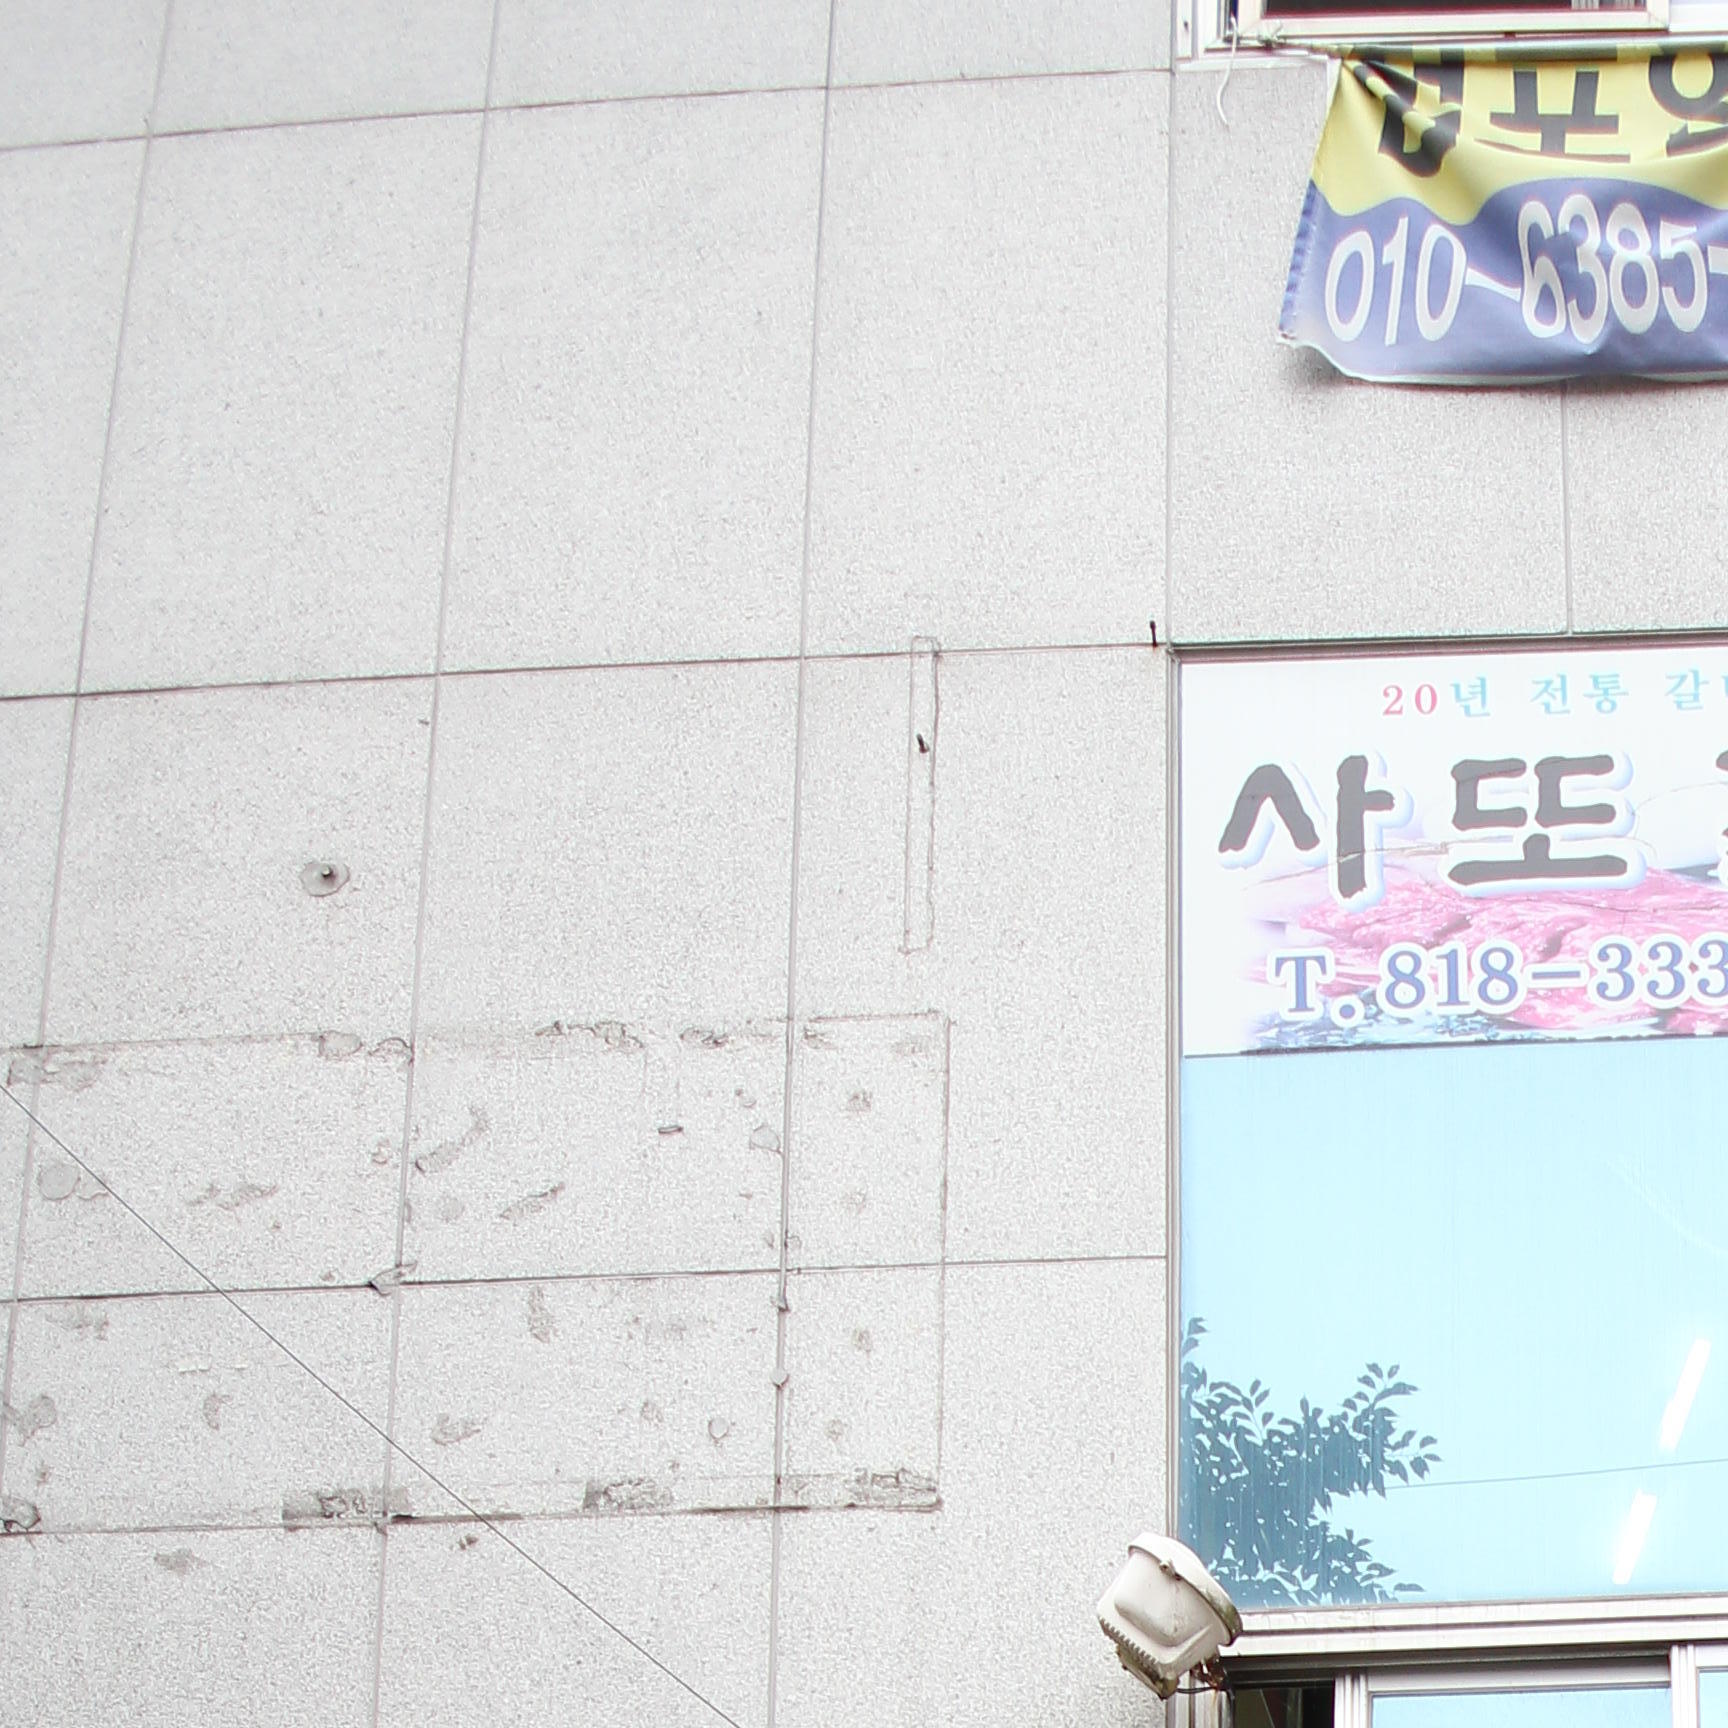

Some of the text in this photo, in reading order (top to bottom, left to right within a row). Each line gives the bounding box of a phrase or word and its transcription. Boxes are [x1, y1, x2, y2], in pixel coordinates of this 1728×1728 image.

[1382, 674, 1495, 718] 20년
[1530, 668, 1630, 717] 전통
[1217, 751, 1630, 901] 사또
